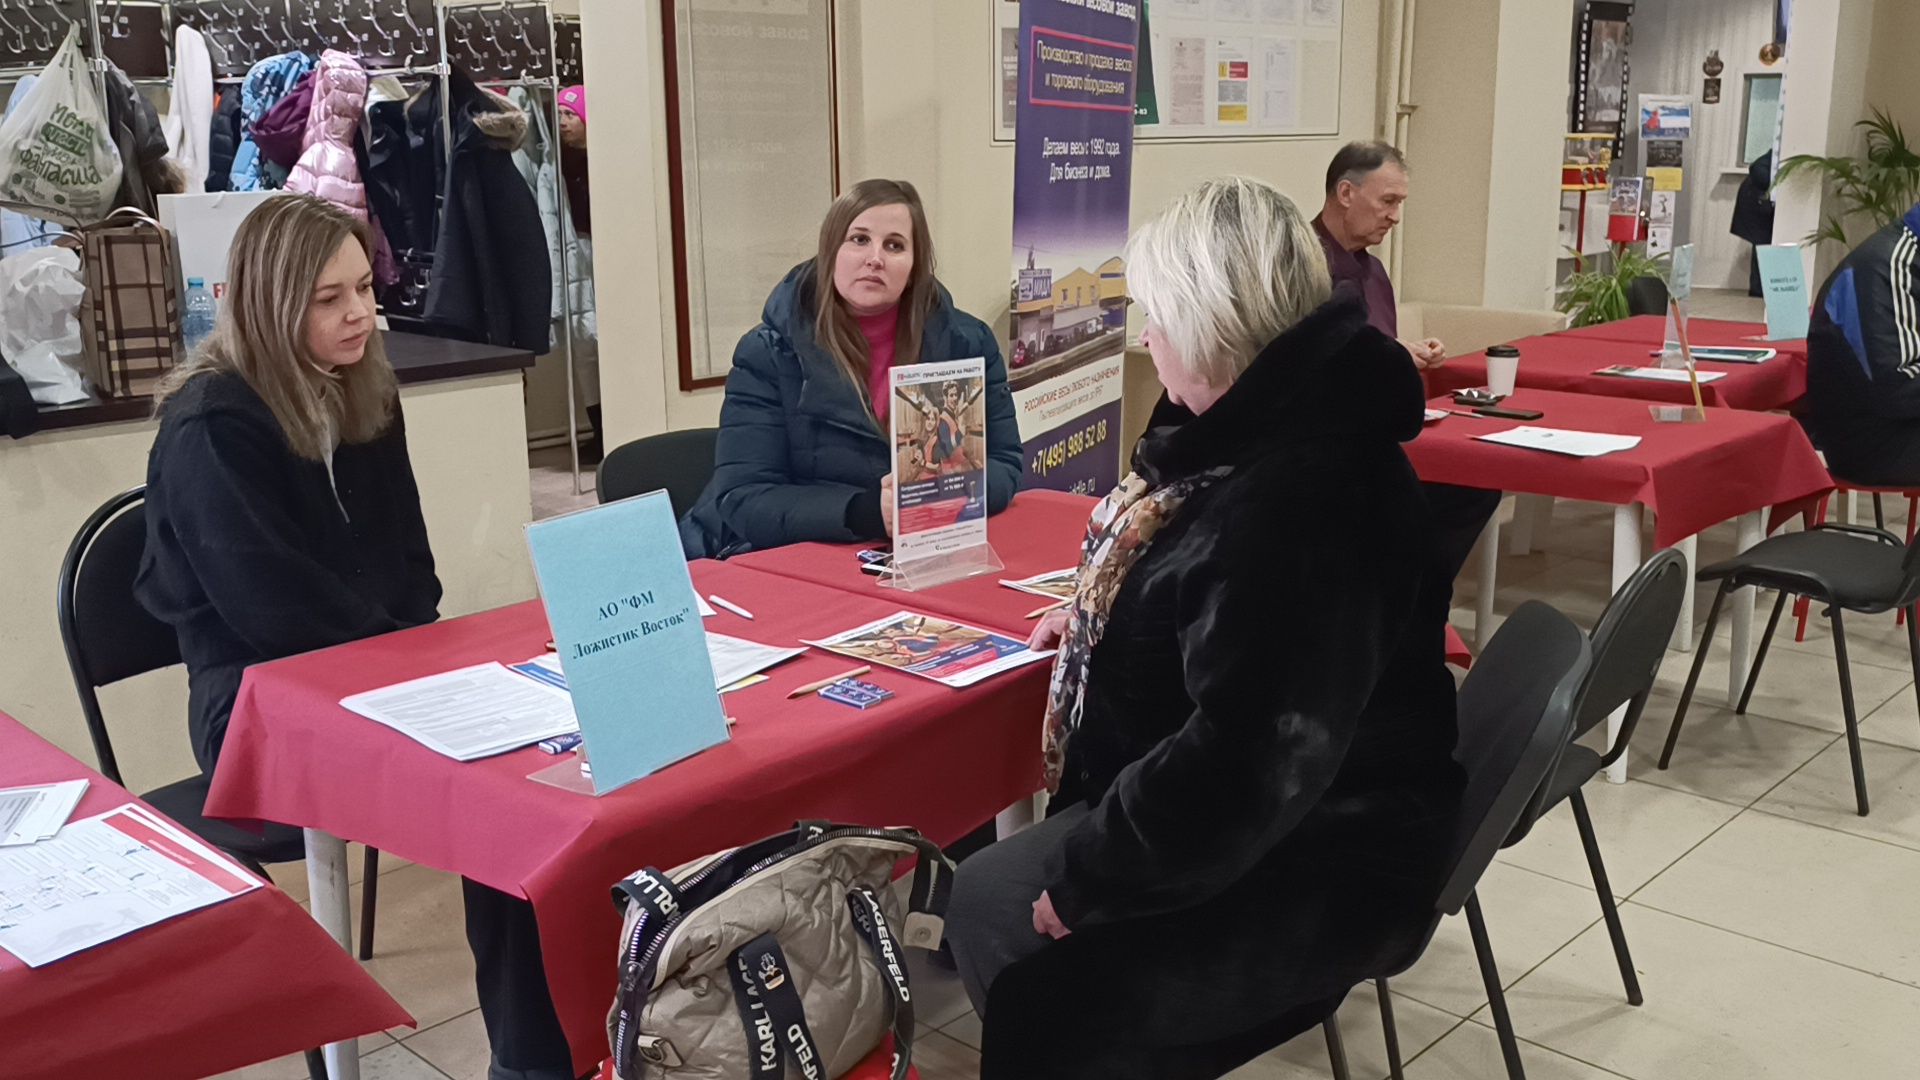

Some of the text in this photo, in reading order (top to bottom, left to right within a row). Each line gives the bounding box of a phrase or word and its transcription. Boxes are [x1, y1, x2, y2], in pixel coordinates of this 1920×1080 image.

[1037, 40, 1083, 67] Производство
[1089, 54, 1114, 71] продажа
[1051, 73, 1083, 91] торгового
[1084, 73, 1125, 96] оборудования
[1042, 136, 1068, 159] Делаем
[1070, 142, 1085, 155] весы
[1090, 138, 1105, 155] 1992
[1049, 162, 1064, 184] Для
[1065, 162, 1088, 180] бизнеса
[1032, 418, 1107, 477] +7(495) 988 52 88
[598, 590, 655, 621] АО "ФМ
[572, 607, 690, 660] Ложистик Восток"
[862, 890, 910, 1002] LAGERFELD
[754, 1010, 777, 1071] KARL
